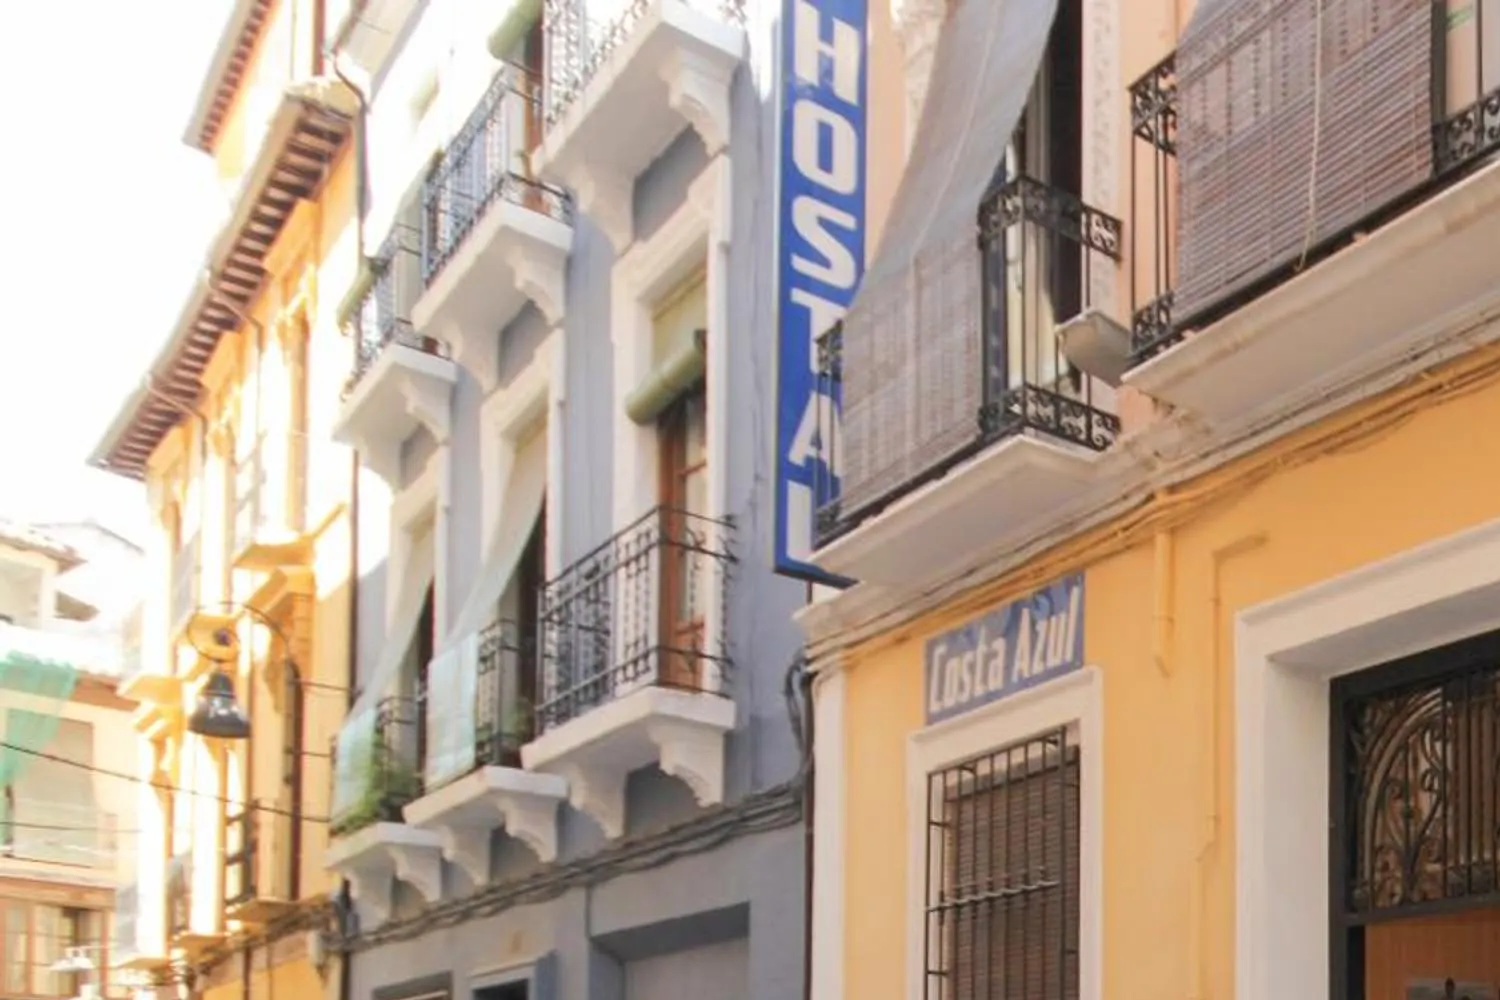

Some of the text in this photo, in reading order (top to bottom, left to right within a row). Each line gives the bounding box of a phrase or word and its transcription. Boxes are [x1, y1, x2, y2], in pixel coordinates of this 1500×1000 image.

[786, 0, 859, 562] HOSTAL
[929, 586, 1080, 713] Costa Azul
